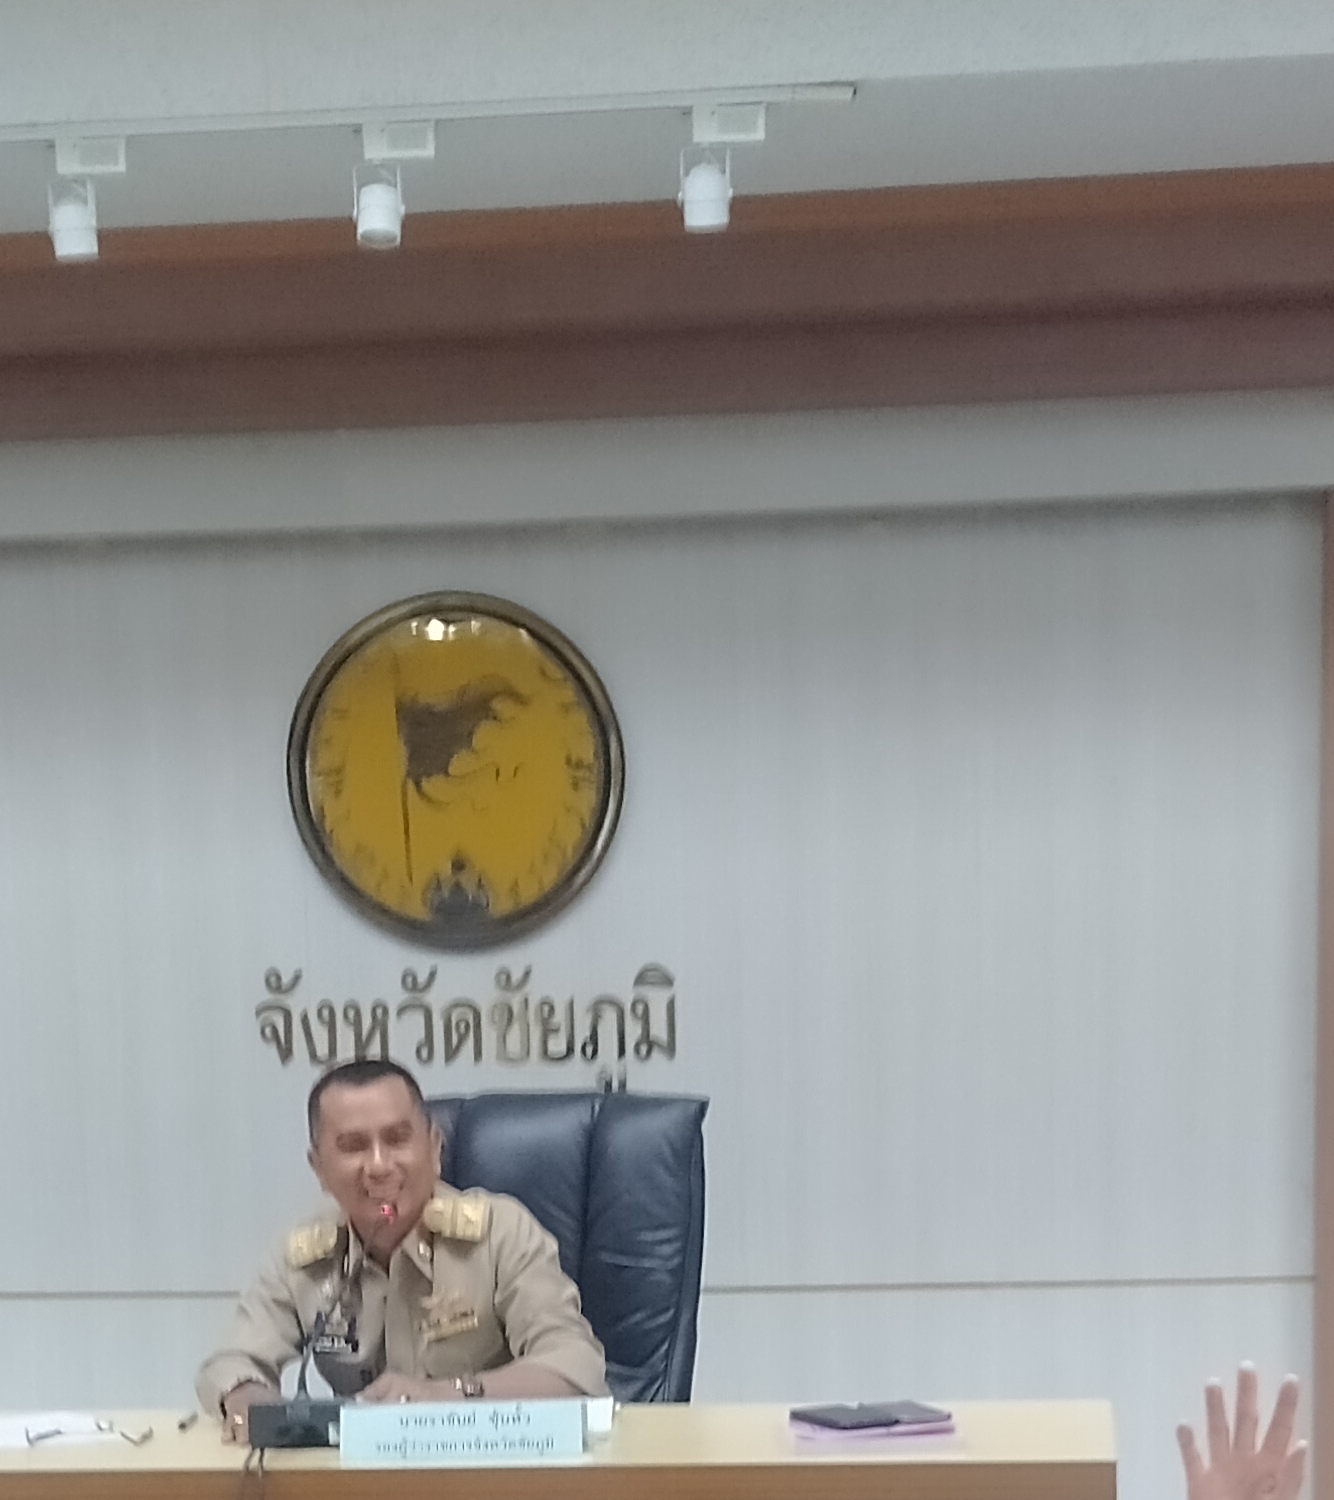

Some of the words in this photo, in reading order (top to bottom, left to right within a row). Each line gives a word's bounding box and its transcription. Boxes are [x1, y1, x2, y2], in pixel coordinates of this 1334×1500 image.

[255, 963, 676, 1094] จังหวัดชัยภูมิ
